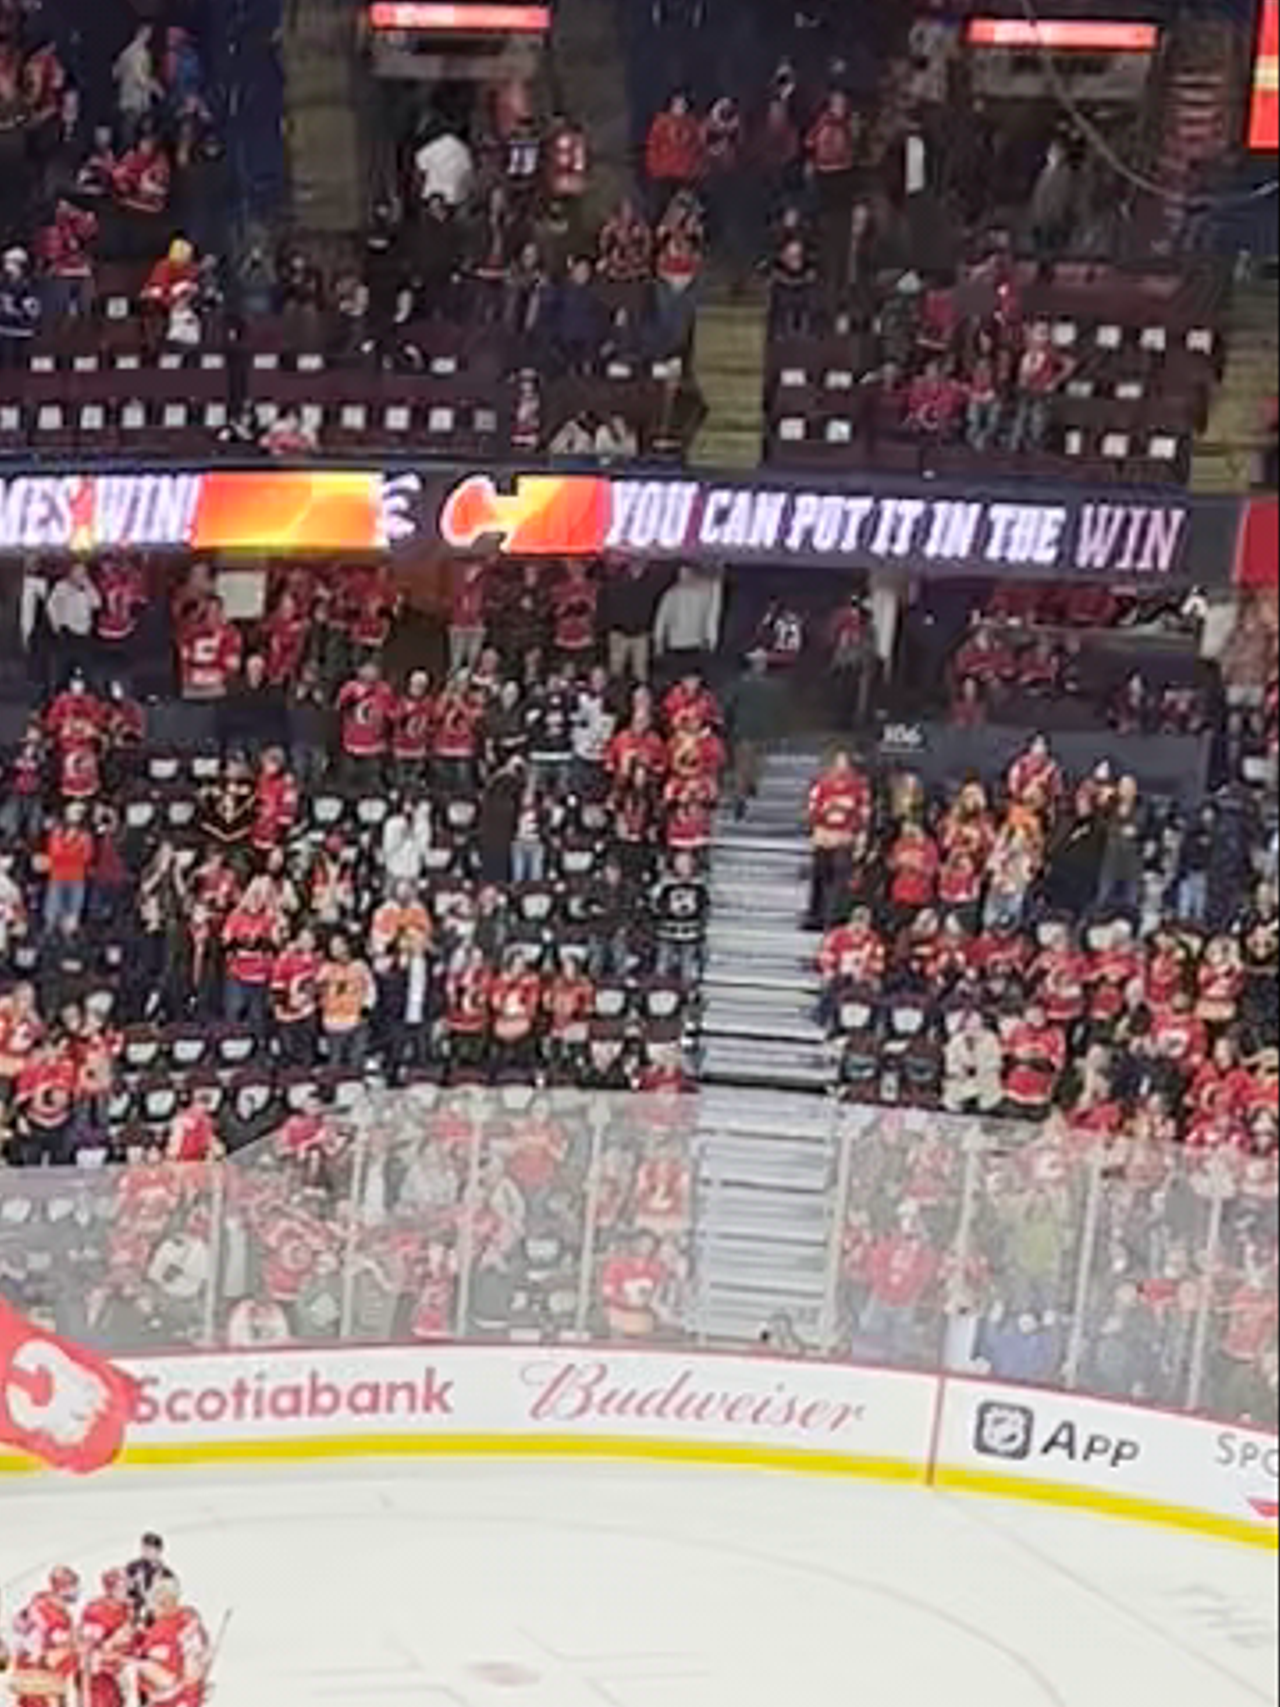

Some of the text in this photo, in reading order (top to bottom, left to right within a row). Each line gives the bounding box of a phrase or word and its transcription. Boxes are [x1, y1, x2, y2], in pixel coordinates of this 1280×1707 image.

[92, 475, 202, 547] WIN!
[606, 481, 1185, 571] YOU CAN PUT IT IN THE WIN
[128, 1366, 454, 1424] Scotiabank
[520, 1362, 866, 1431] Budweiser
